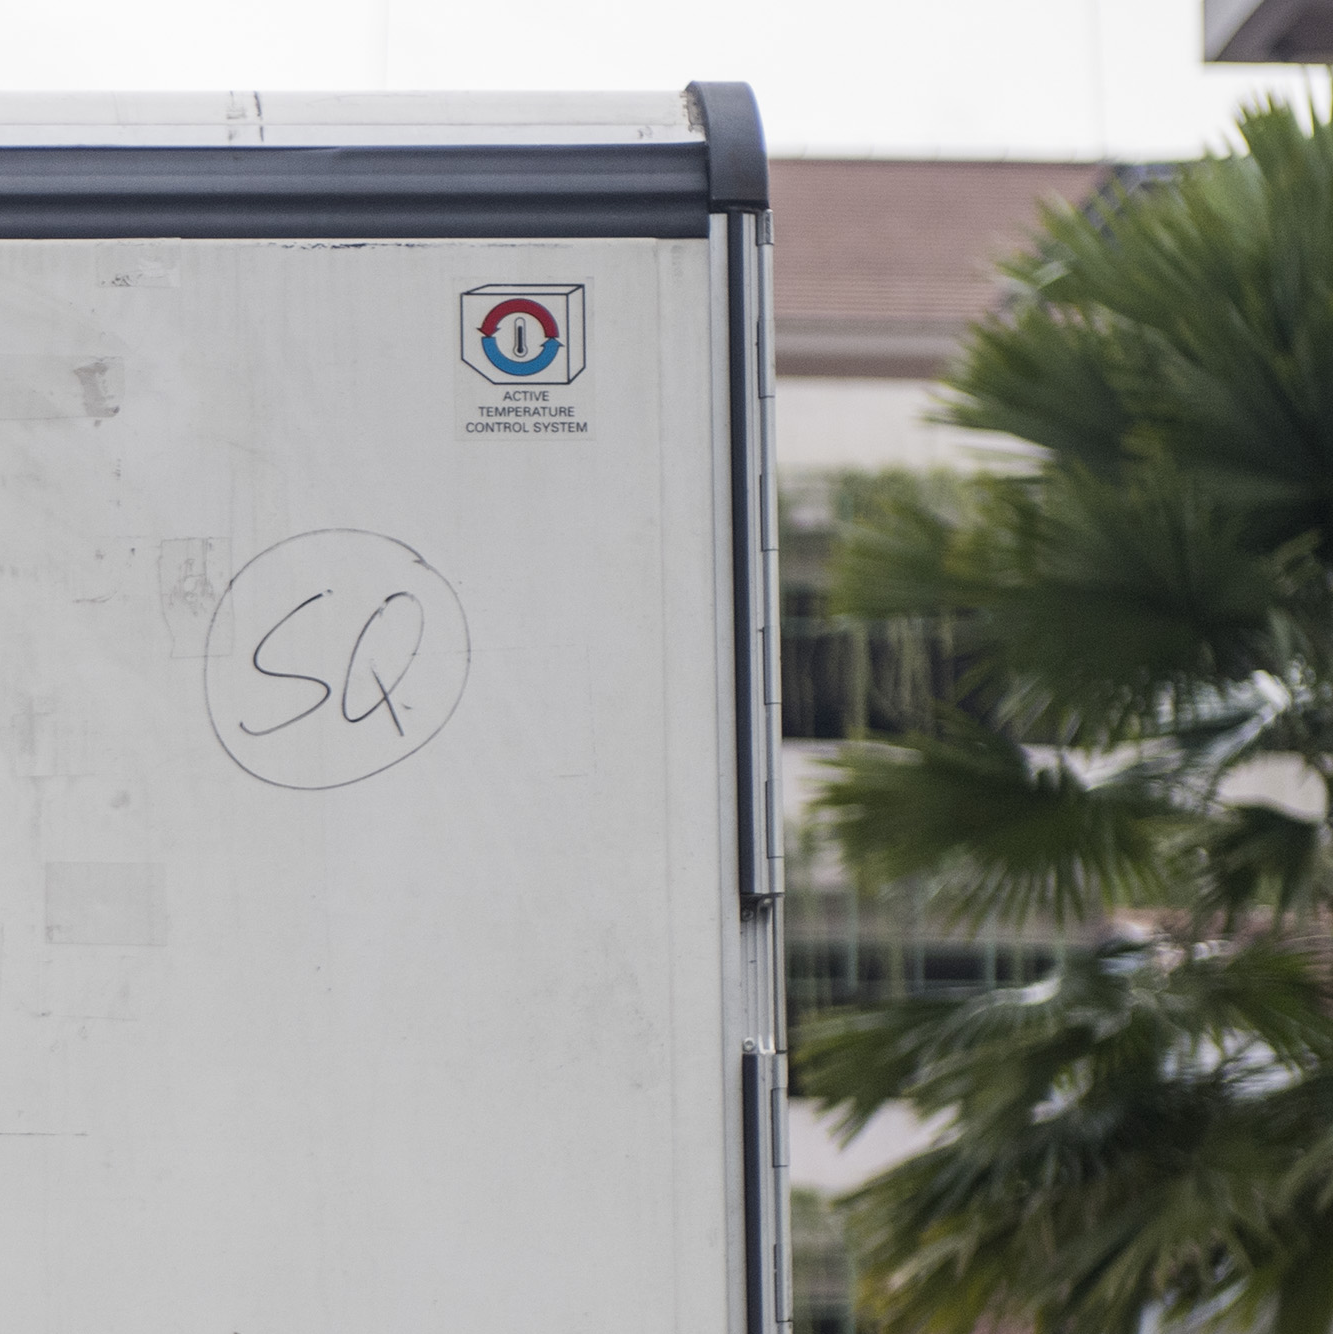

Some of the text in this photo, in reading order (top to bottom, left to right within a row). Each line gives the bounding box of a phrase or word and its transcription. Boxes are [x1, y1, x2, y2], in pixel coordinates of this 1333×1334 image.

[503, 391, 550, 402] ACTIVE
[478, 407, 575, 417] TEMPERATURE
[465, 422, 588, 433] CONTROL SYSTEM
